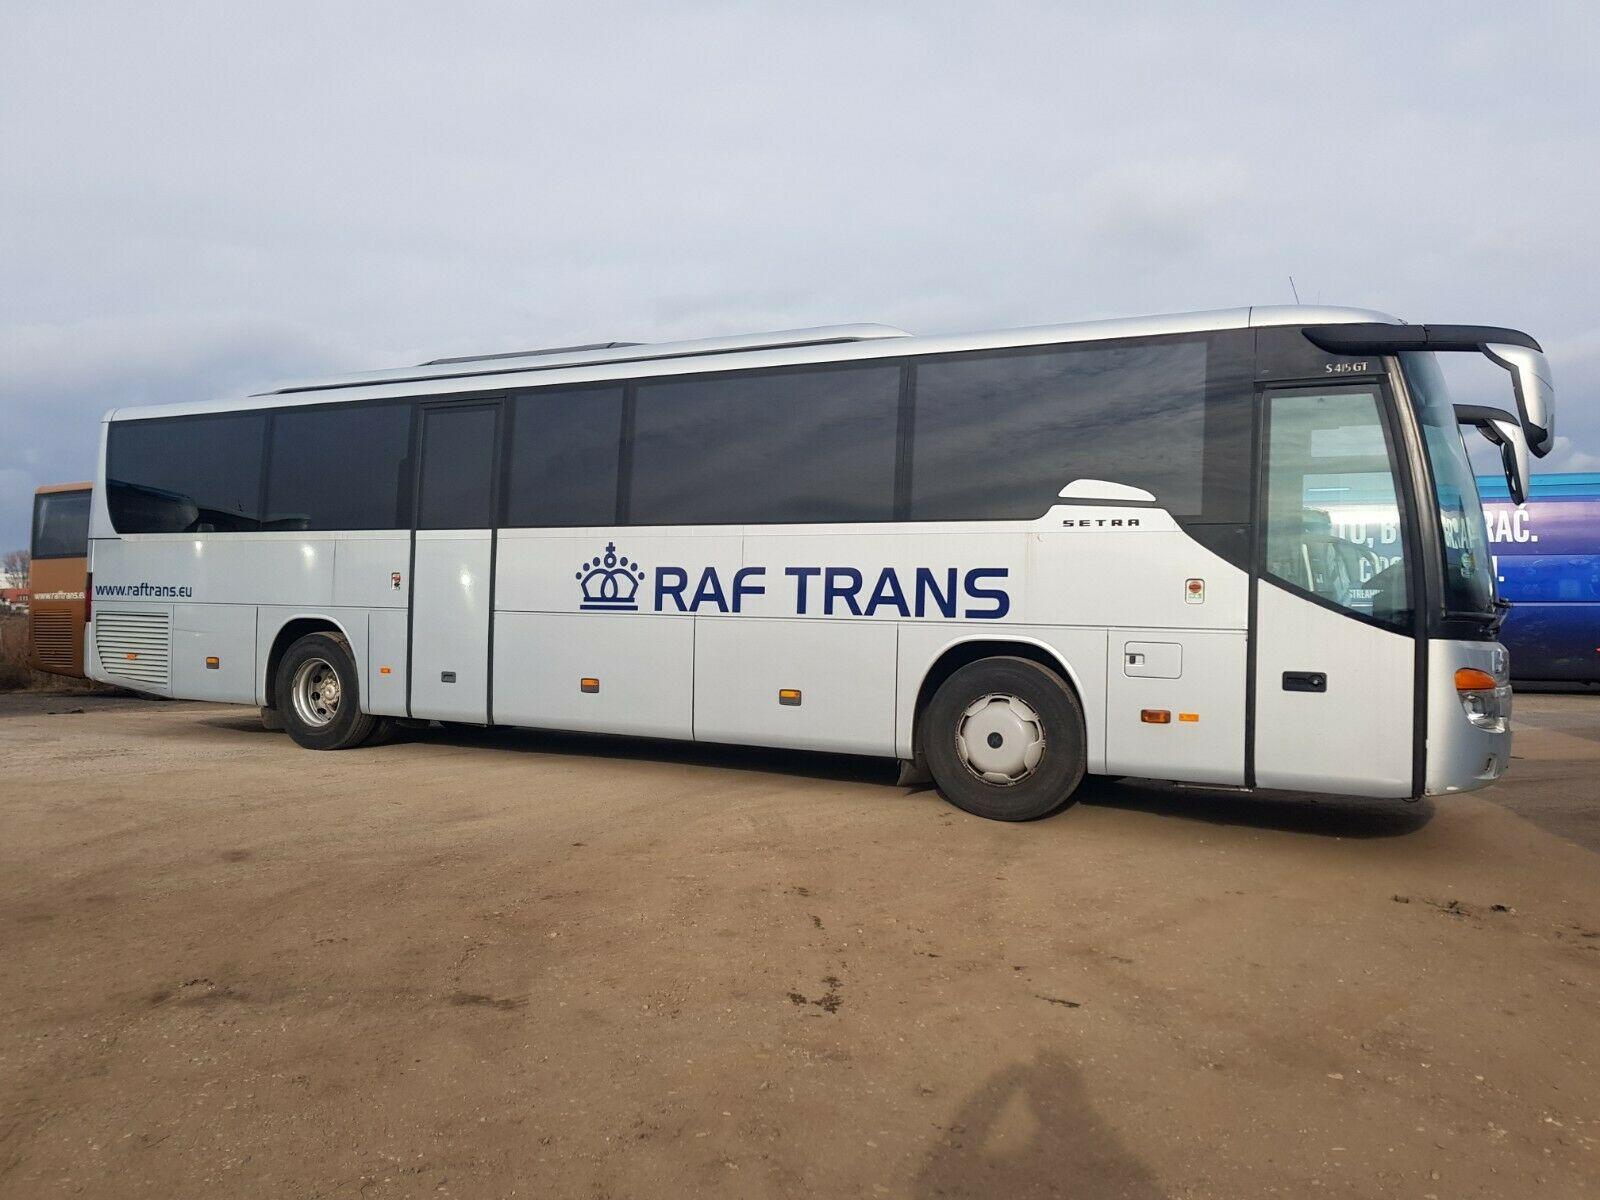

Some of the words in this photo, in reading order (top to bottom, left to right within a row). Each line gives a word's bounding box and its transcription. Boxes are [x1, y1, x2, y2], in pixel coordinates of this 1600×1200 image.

[1325, 363, 1333, 373] S
[1334, 363, 1352, 373] 415
[1353, 361, 1369, 372] GT
[1062, 519, 1140, 528] SETRA
[94, 582, 193, 598] www.raftrans.eu
[654, 566, 767, 614] RAF
[784, 567, 1010, 620] TRANS
